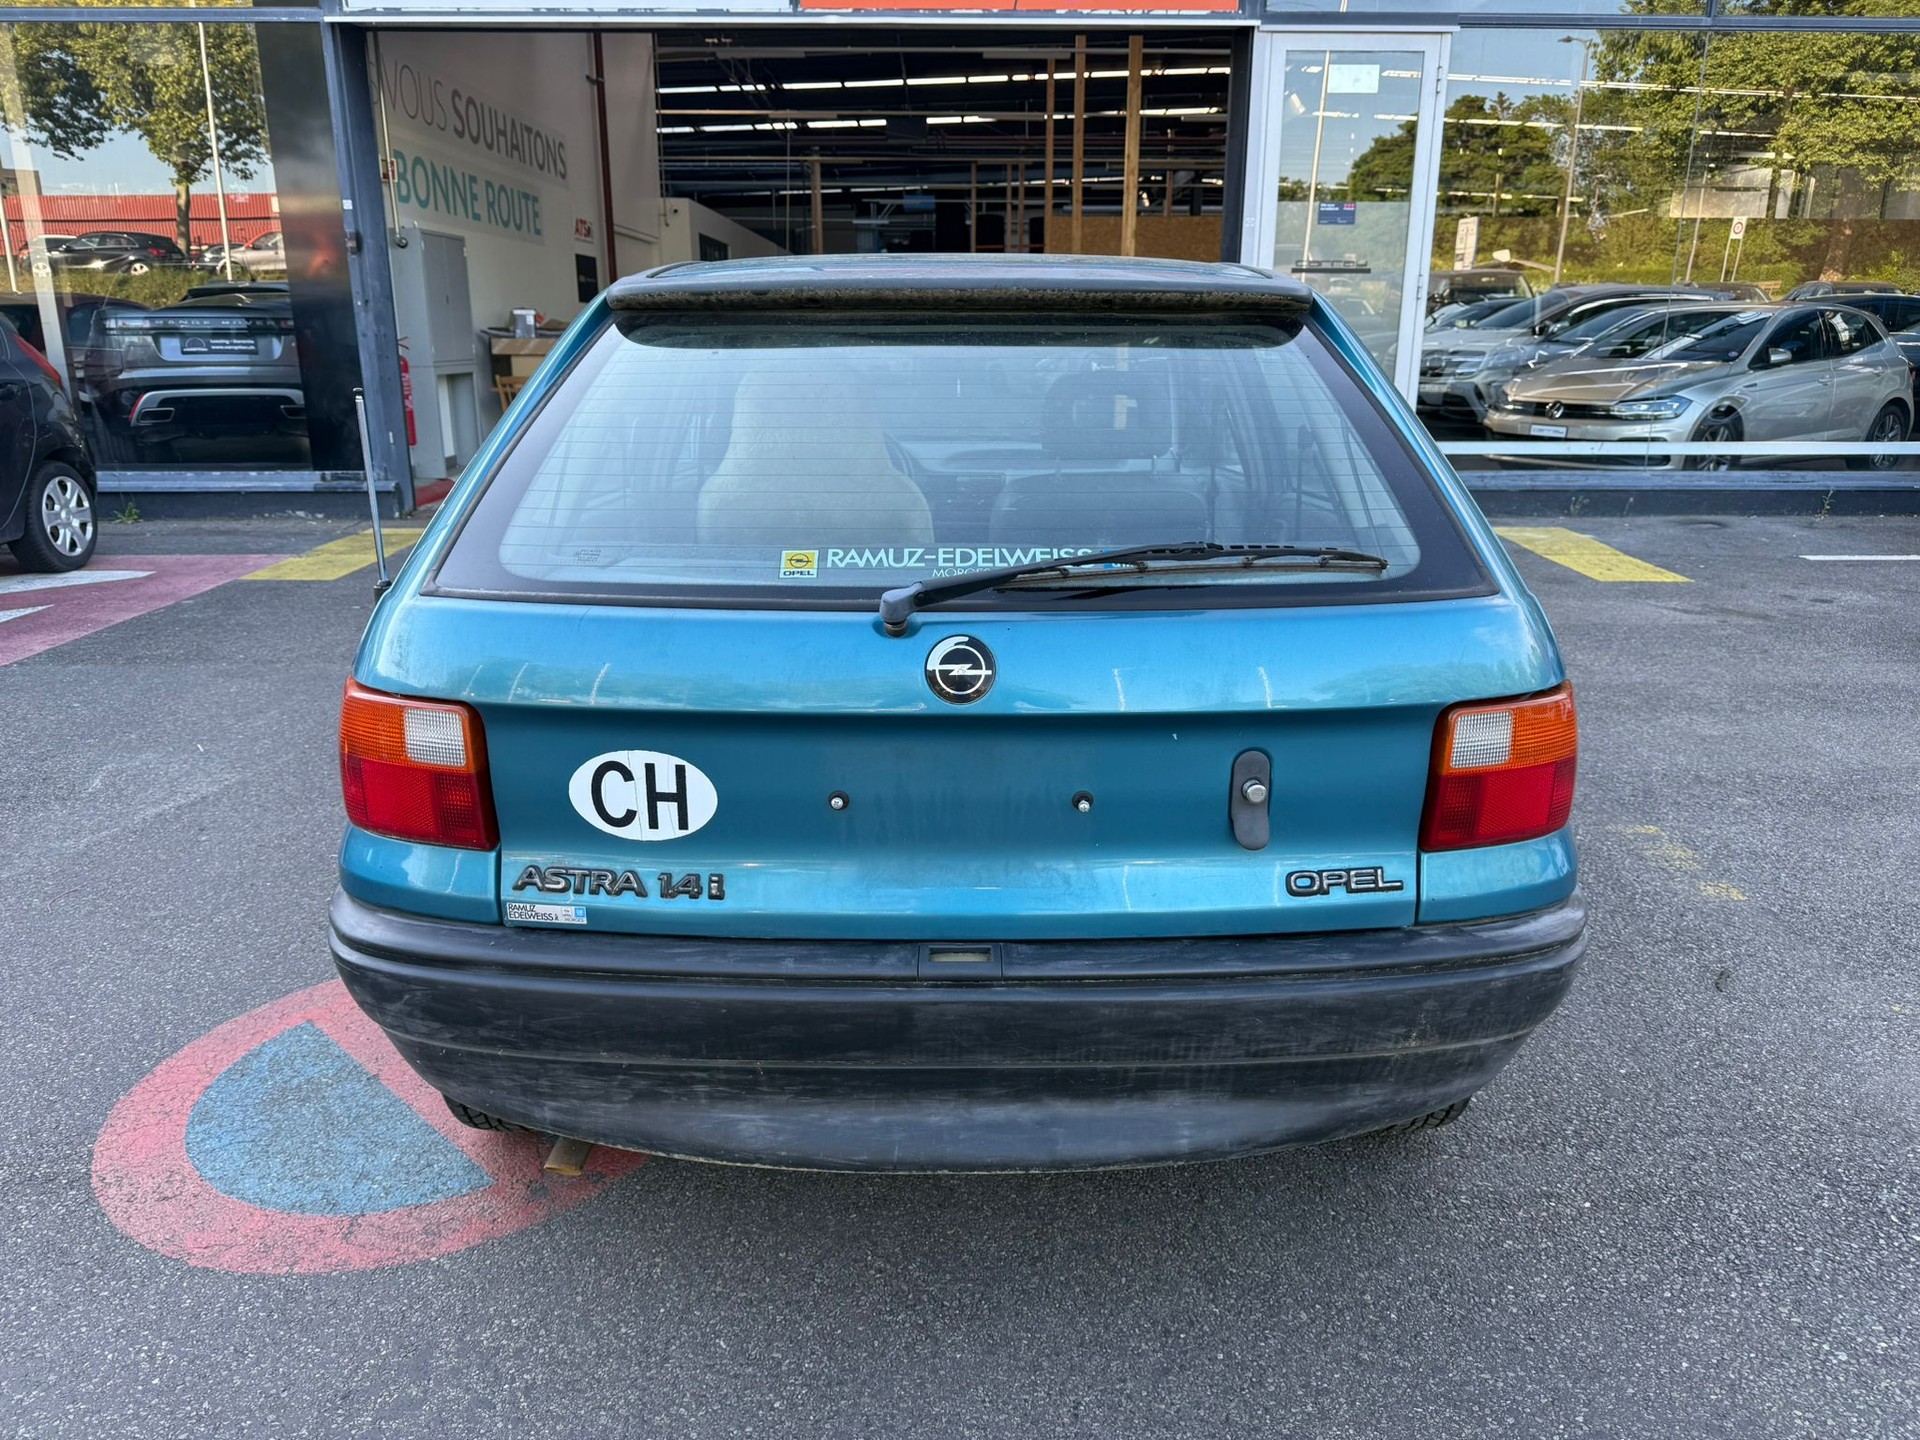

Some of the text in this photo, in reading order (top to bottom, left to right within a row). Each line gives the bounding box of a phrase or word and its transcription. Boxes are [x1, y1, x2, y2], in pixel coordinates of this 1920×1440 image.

[381, 54, 447, 131] VOUS
[451, 88, 567, 180] SOUHAITONS
[394, 149, 542, 236] BONNE ROUTE
[826, 547, 1094, 568] RAMUZ-EDELWEISS
[591, 760, 689, 831] CH
[512, 865, 648, 898] ASTRA
[1285, 866, 1404, 897] OPEL
[508, 903, 537, 912] RAMUZ
[508, 911, 554, 921] EDELWEISS
